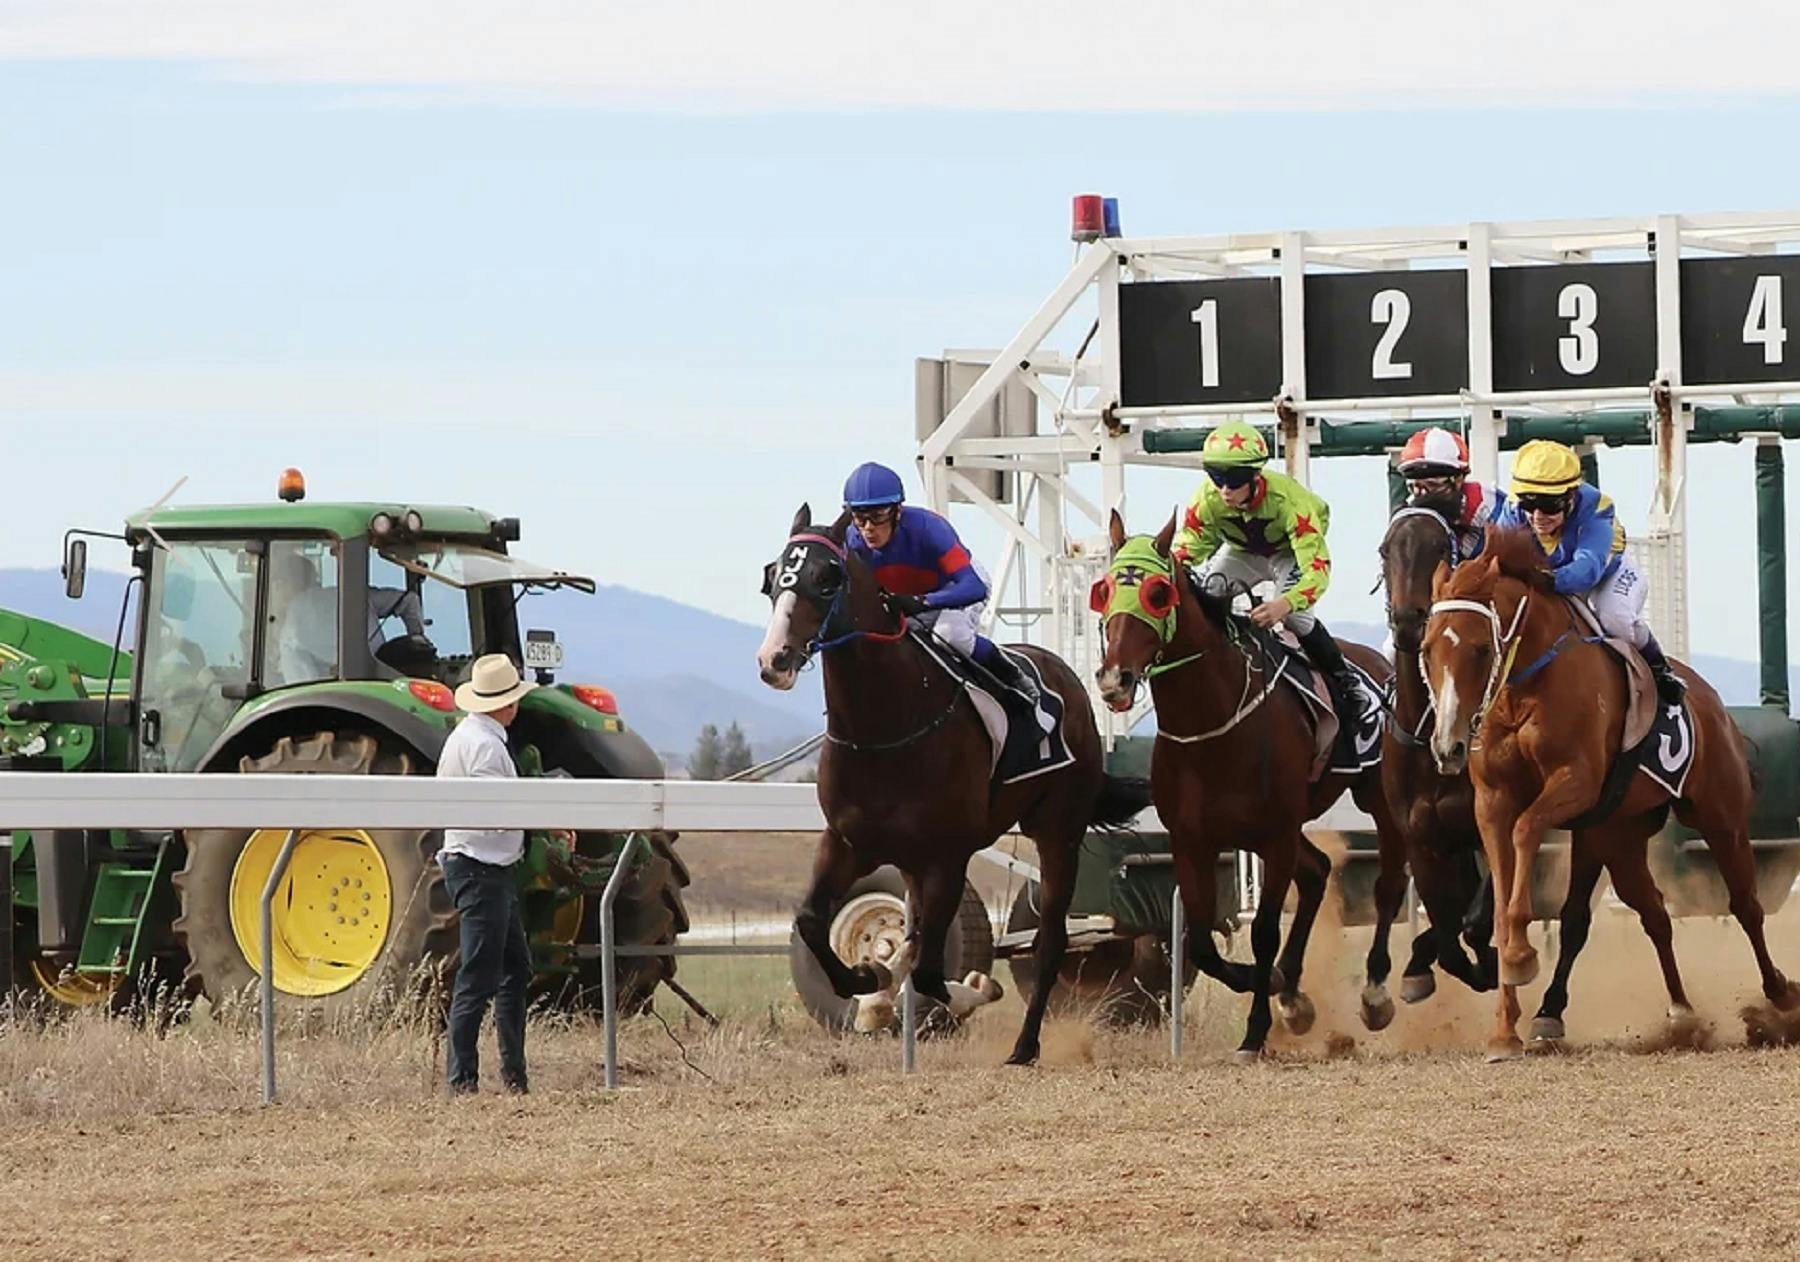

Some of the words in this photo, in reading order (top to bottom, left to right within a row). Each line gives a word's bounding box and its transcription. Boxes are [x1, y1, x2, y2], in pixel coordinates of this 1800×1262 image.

[1191, 300, 1219, 387] 1
[1372, 290, 1412, 378] 2
[1558, 284, 1599, 375] 3
[1743, 276, 1787, 364] 4
